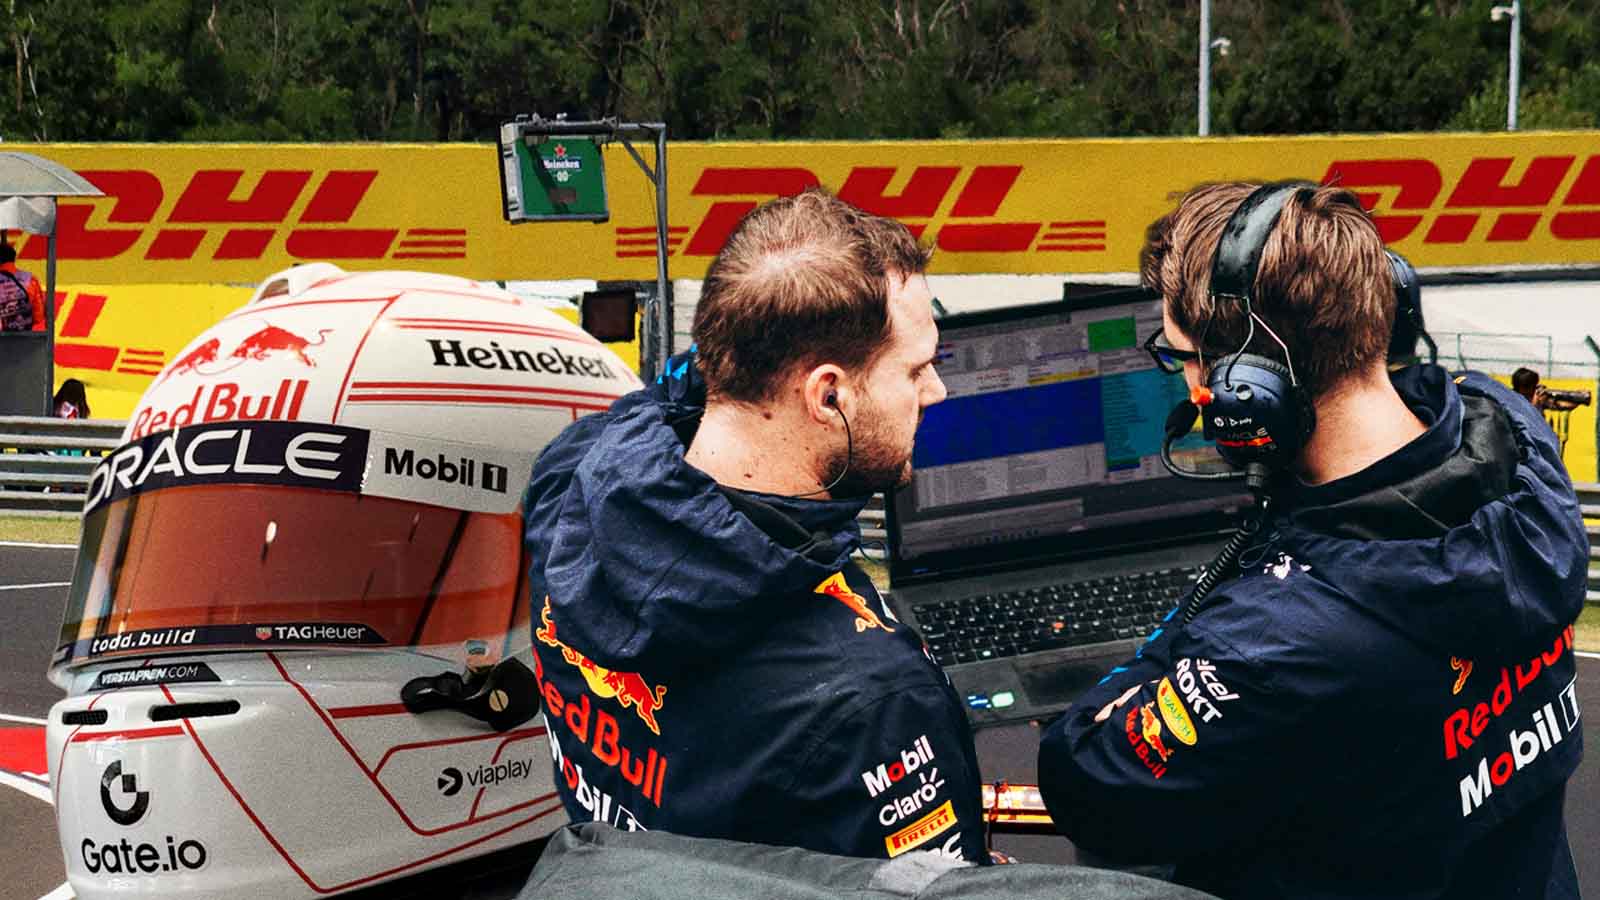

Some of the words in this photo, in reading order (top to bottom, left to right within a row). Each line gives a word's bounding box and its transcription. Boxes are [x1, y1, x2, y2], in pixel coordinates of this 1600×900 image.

[18, 170, 399, 260] DHL
[426, 338, 618, 380] Heineken
[131, 385, 203, 442] Red
[203, 379, 309, 422] Bull
[84, 429, 347, 513] ORACLE
[384, 447, 475, 486] Mobil
[481, 461, 508, 494] 1
[92, 629, 196, 653] todd.build
[101, 665, 198, 685] VERSTAPPEN.COM
[1176, 657, 1223, 723] ROKT
[1443, 666, 1513, 760] Red
[466, 759, 533, 788] viaplay
[591, 708, 668, 809] Bull
[861, 734, 935, 798] Mobil
[1459, 702, 1563, 817] Mobil
[878, 766, 945, 826] Claro
[81, 836, 207, 874] Gate.io
[891, 807, 951, 850] PIRELLI
